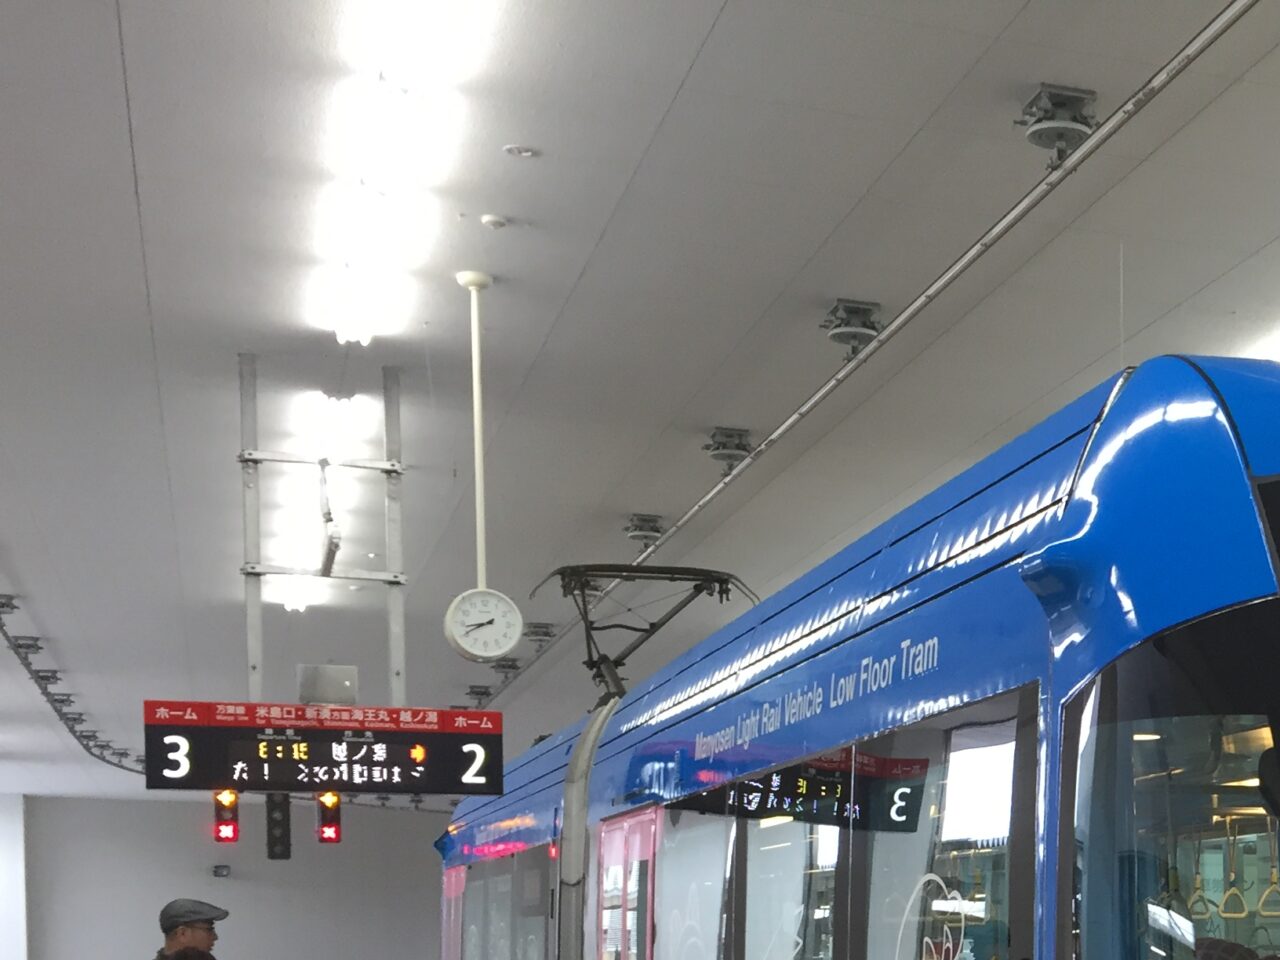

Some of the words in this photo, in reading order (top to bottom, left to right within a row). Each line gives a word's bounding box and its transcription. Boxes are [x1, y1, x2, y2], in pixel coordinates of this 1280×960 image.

[155, 707, 198, 720] ホーム
[695, 725, 735, 764] Manyosen
[736, 708, 760, 750] Light
[761, 698, 782, 735] Rail
[784, 681, 823, 726] Vehicle
[830, 672, 857, 709] Low
[859, 655, 896, 697] Floor
[901, 637, 939, 680] Tram
[454, 715, 493, 729] ホーム
[162, 734, 190, 778] 3
[461, 743, 487, 784] 2
